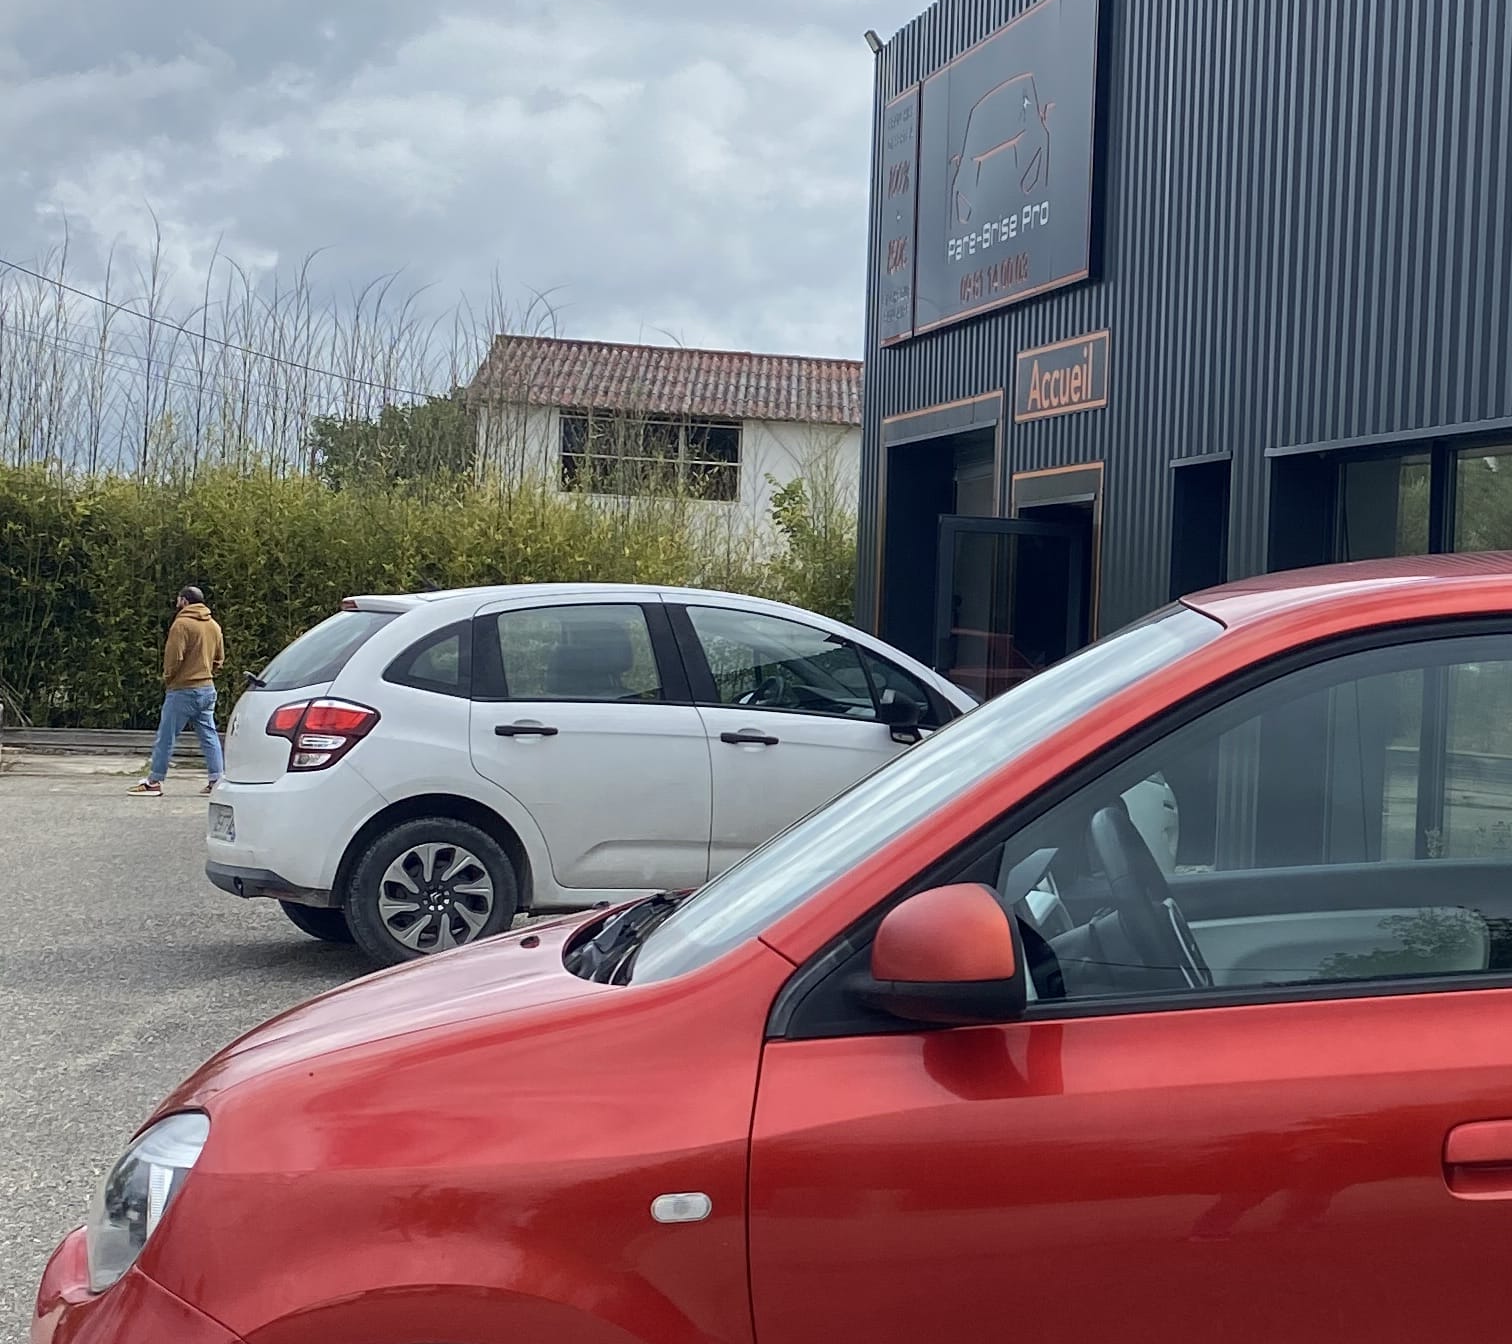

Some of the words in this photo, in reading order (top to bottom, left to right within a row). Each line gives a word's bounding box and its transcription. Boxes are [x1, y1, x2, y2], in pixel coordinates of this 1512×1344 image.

[947, 213, 1018, 264] Pare-Brise
[1021, 200, 1049, 233] Pro
[1027, 341, 1094, 411] Accueil
